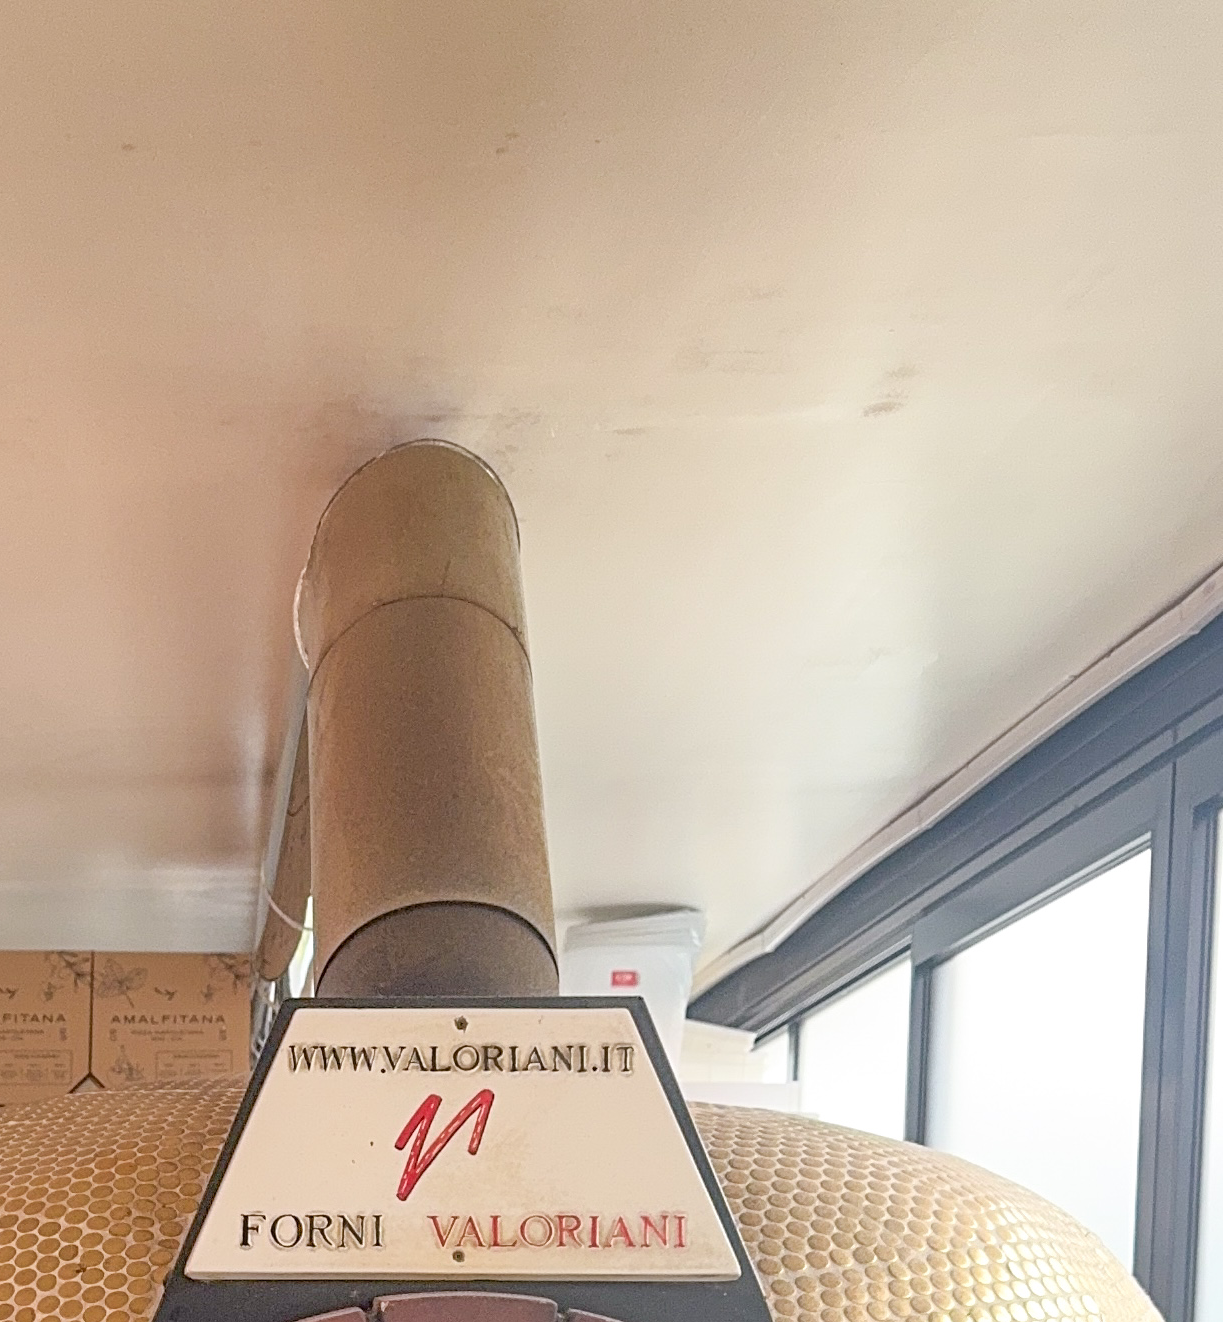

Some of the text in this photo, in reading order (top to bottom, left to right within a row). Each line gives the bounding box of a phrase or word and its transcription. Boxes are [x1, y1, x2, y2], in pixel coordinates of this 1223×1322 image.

[112, 1015, 225, 1024] AMALFITANA
[288, 1044, 635, 1074] WWW.VALORIANI.IT
[240, 1213, 688, 1249] FORNI VALORIANI
